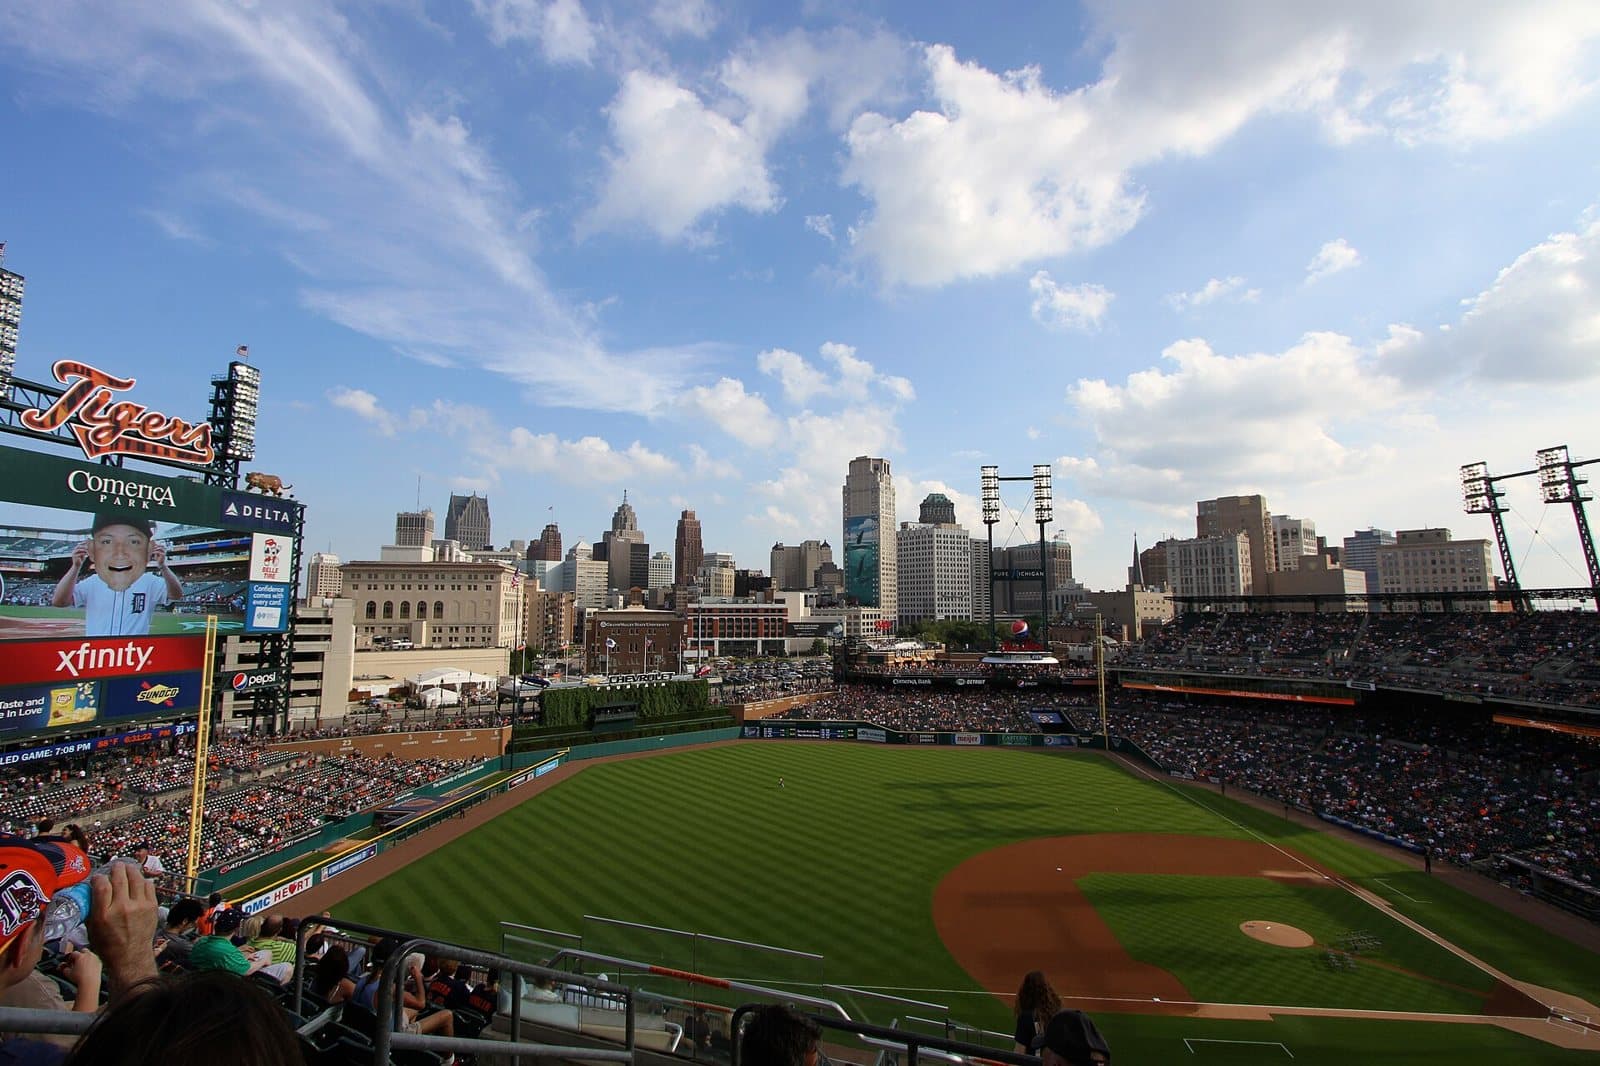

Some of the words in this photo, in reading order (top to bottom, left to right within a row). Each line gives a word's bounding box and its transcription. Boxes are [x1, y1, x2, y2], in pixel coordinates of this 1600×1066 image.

[20, 360, 214, 464] Tigers
[100, 494, 149, 509] PARK
[243, 504, 290, 523] DELTA
[253, 585, 284, 593] Confidence
[55, 642, 154, 677] xfinity
[248, 671, 276, 687] pepsi
[609, 671, 674, 684] CHEVROLET
[596, 682, 666, 692] FOUNTAIN
[138, 689, 179, 700] SUNOCO
[25, 697, 45, 707] and
[7, 709, 16, 718] In
[20, 707, 43, 717] Love
[21, 749, 53, 761] GAME:
[55, 745, 75, 756] 7:08
[76, 742, 92, 752] PM
